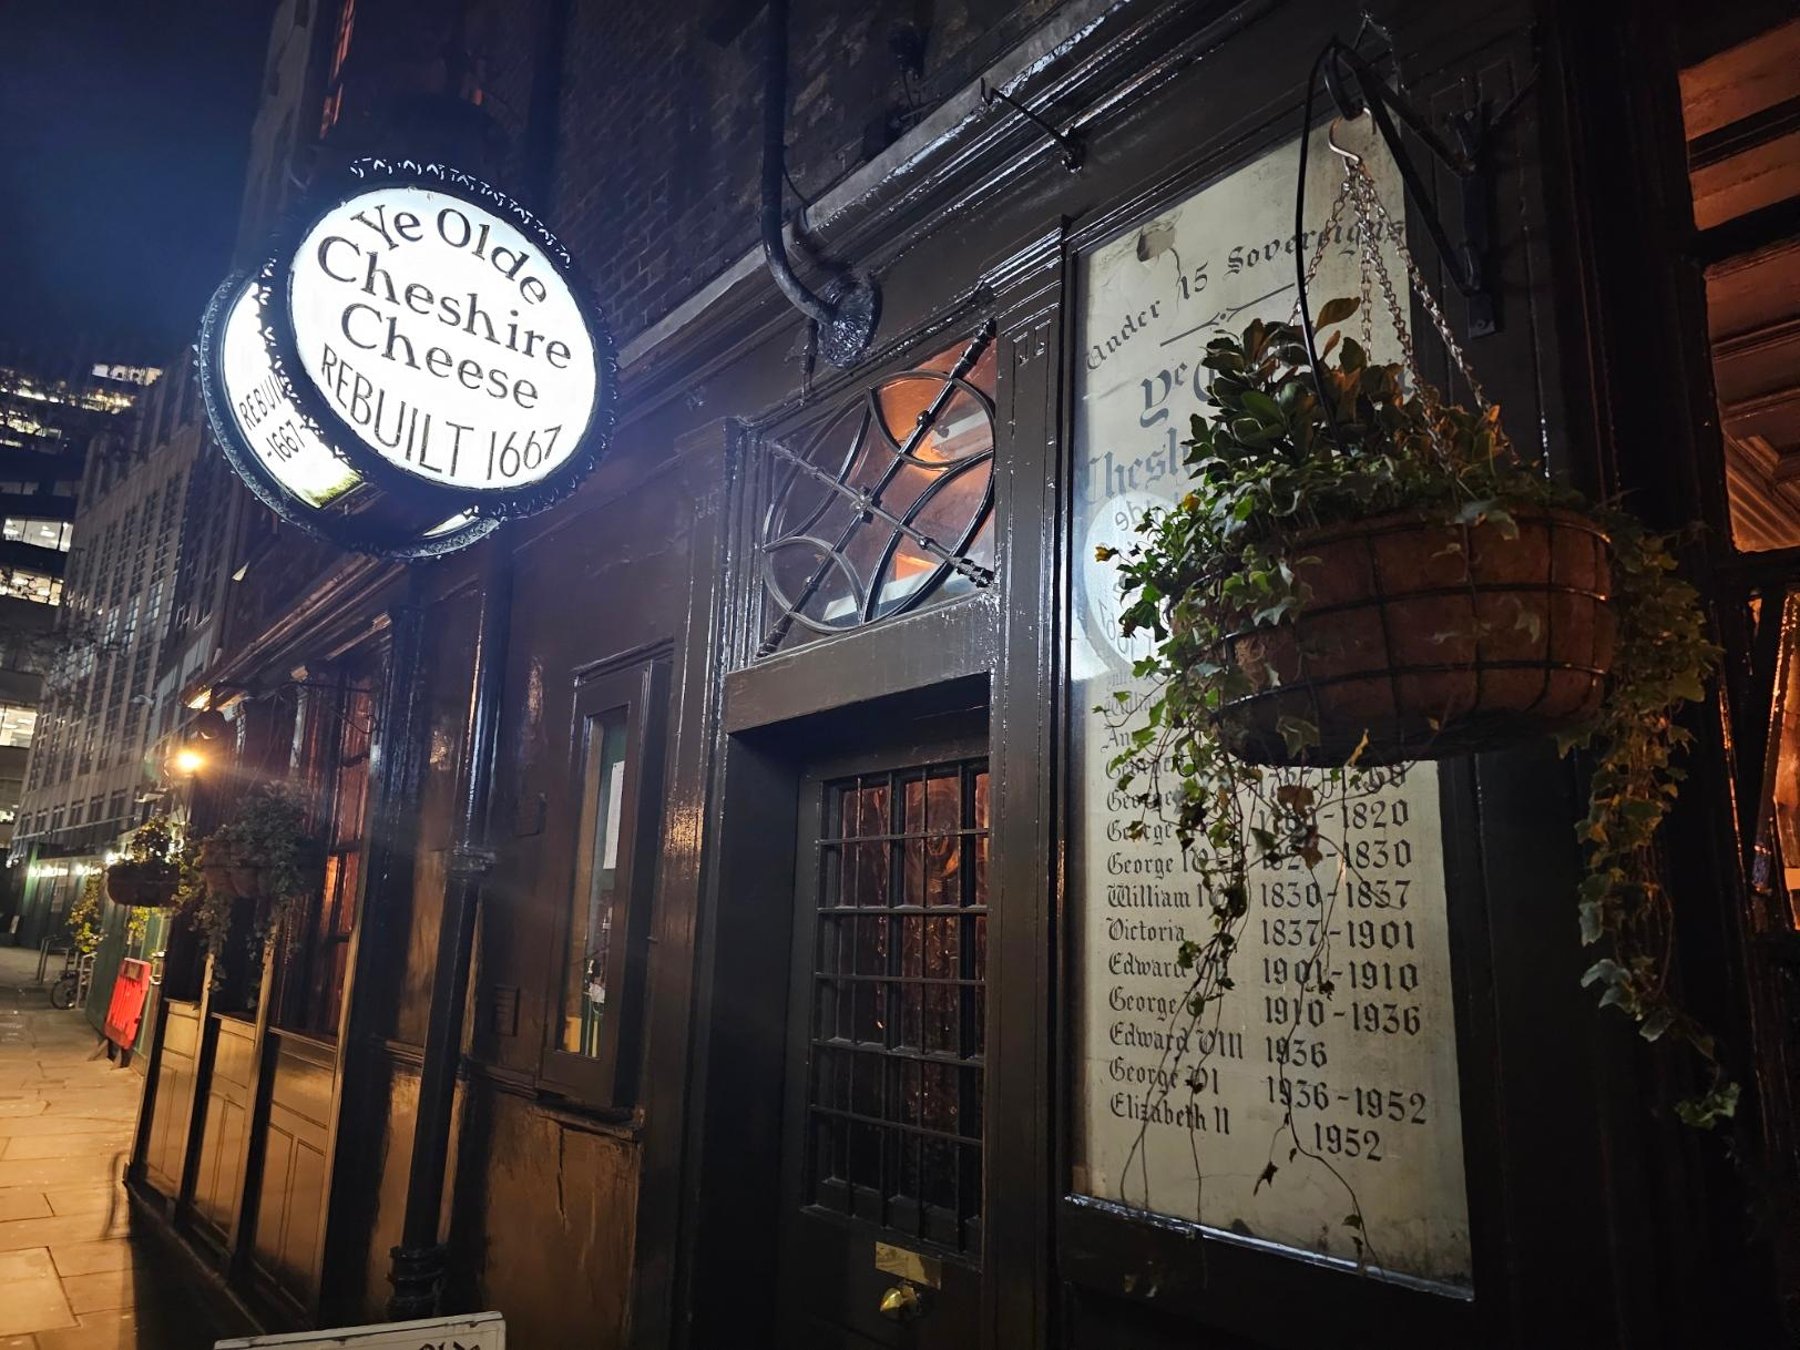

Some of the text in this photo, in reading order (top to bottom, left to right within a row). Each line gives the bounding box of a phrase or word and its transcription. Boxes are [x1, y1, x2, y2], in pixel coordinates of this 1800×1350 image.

[350, 204, 548, 305] Ye Olde
[1178, 261, 1208, 300] 15
[317, 235, 572, 369] Cheshire
[341, 302, 539, 409] Cheese
[321, 343, 563, 481] REBUILT 1667
[1107, 819, 1172, 846] Gerge
[1107, 852, 1173, 879] George
[1107, 884, 1191, 908] William
[1106, 917, 1185, 941] Victoria
[1109, 986, 1177, 1021] George
[1109, 1022, 1189, 1053] Edward
[1266, 1036, 1328, 1068] 1936
[1109, 1056, 1178, 1095] George
[1110, 1092, 1207, 1132] Elizabeth
[1314, 1122, 1382, 1162] 1952
